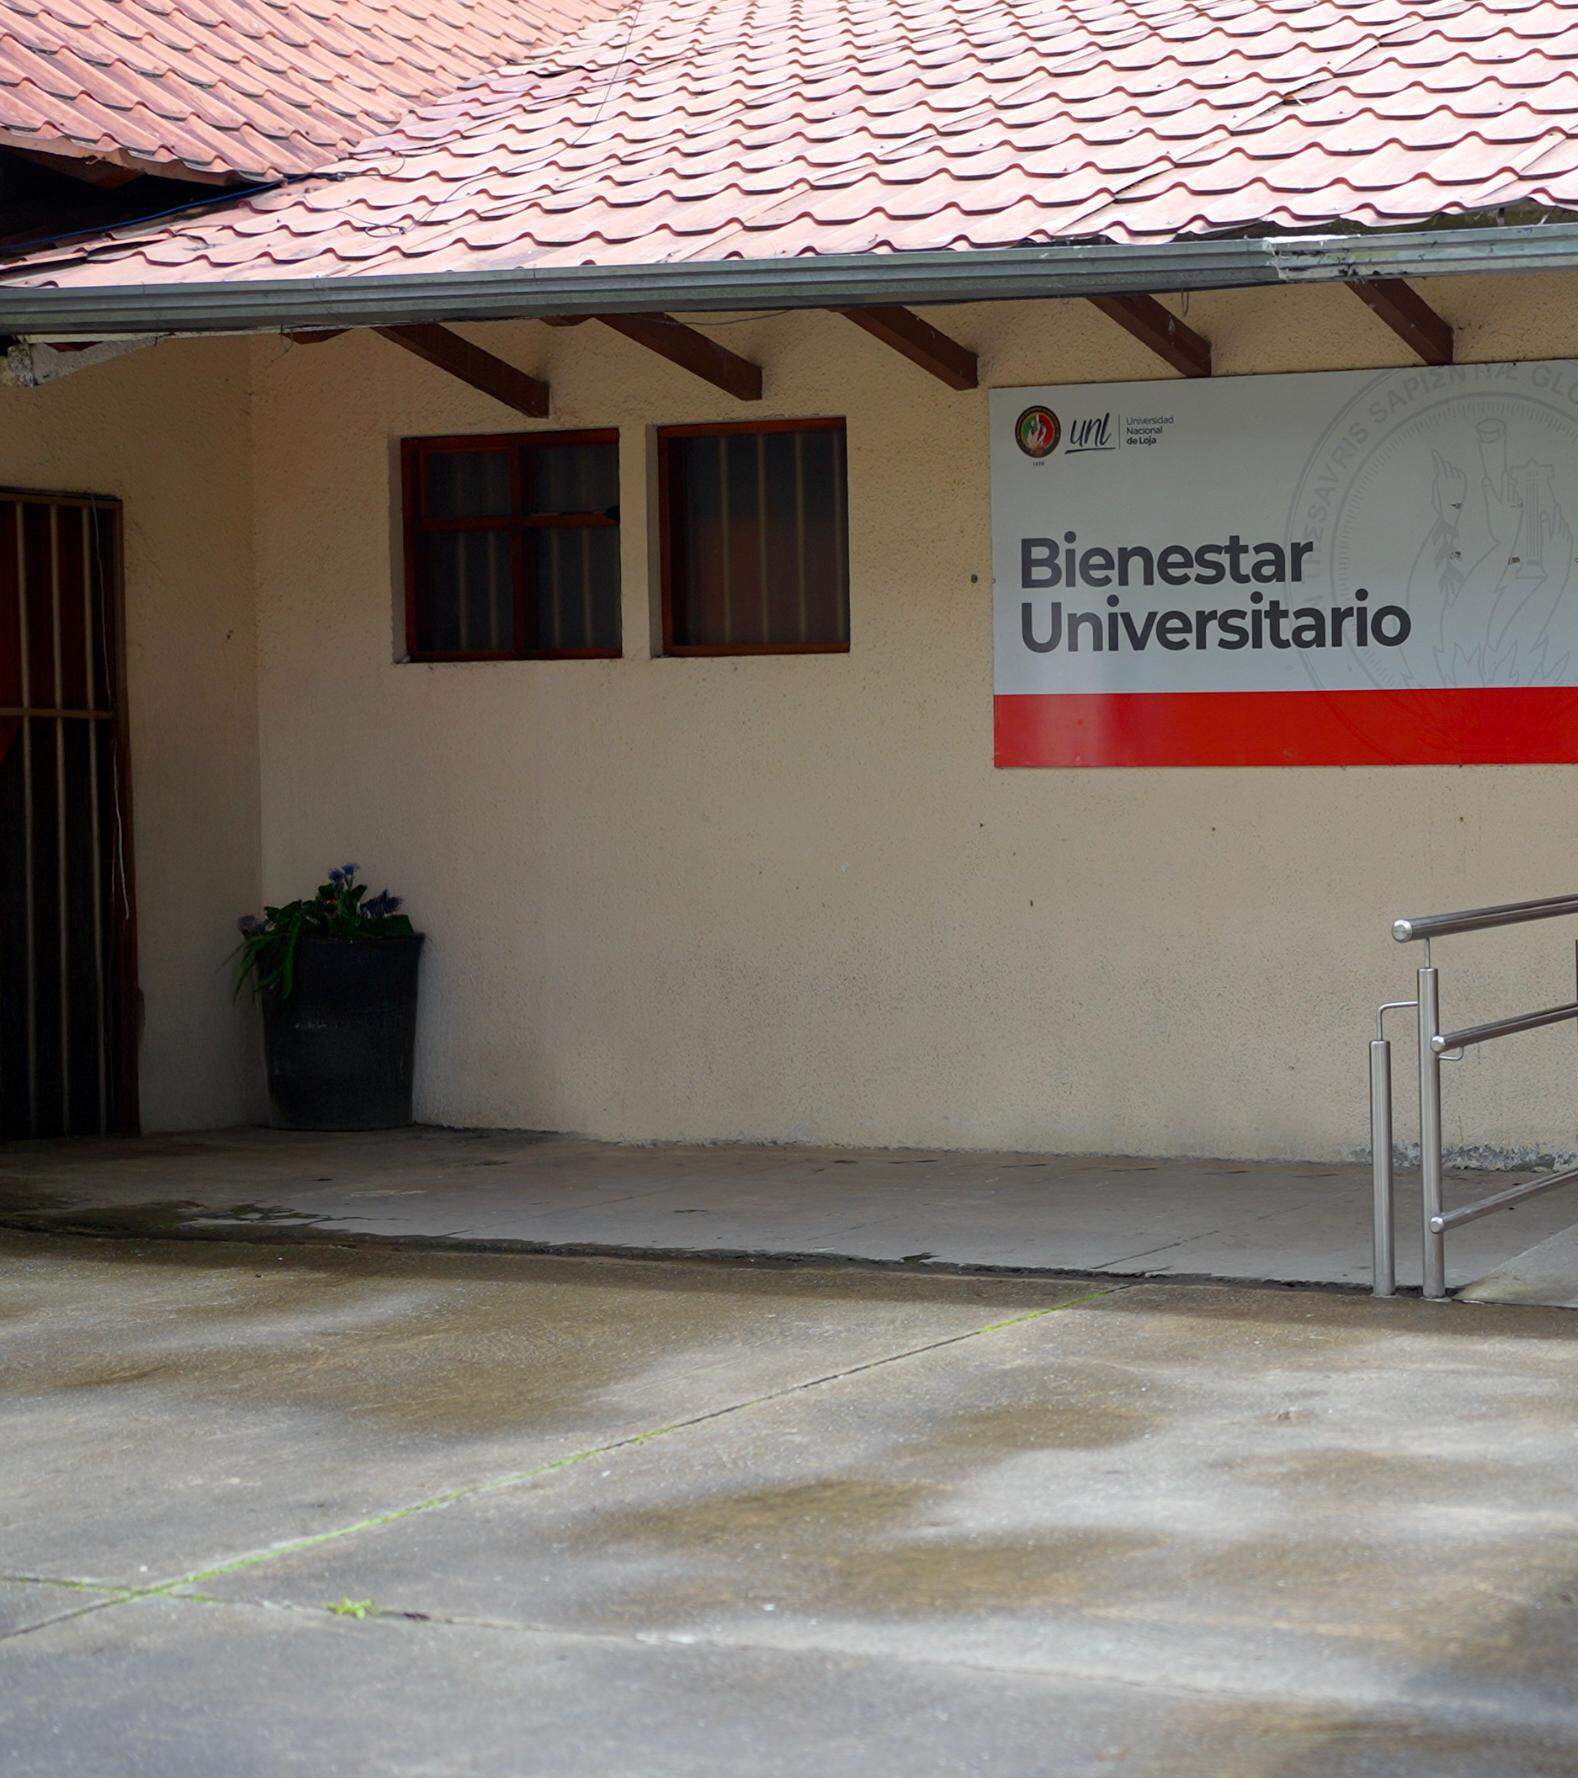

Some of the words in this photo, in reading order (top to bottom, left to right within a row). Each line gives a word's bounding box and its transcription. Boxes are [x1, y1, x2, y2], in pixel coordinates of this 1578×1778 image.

[1069, 412, 1112, 447] unl
[1126, 415, 1175, 425] Universidad
[1126, 426, 1163, 435] Nacional
[1126, 437, 1138, 445] de
[1139, 436, 1157, 447] Loja
[1021, 531, 1313, 589] Bienestar
[1021, 588, 1412, 654] Universitario
